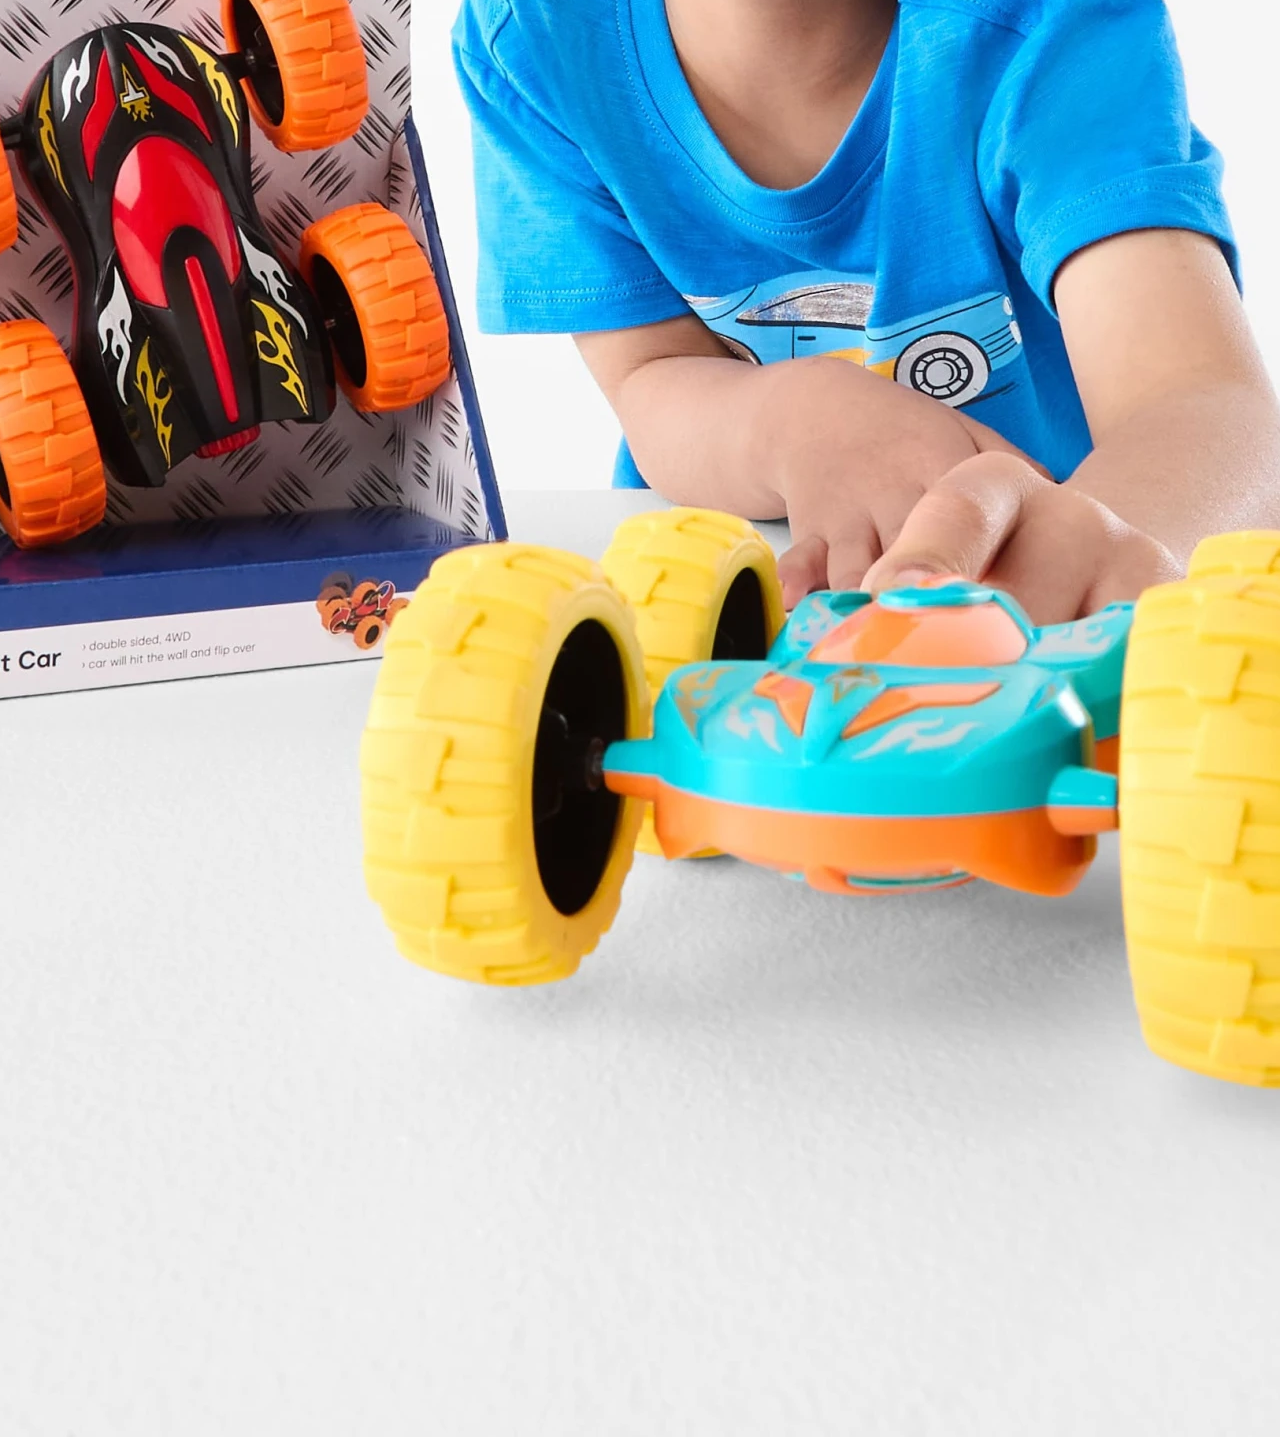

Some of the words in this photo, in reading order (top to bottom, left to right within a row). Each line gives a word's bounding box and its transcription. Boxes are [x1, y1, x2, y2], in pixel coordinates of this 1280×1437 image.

[89, 638, 127, 651] double
[165, 631, 192, 643] 4WD
[18, 650, 62, 669] Car
[88, 659, 106, 669] car
[110, 656, 127, 667] will
[130, 653, 143, 665] hit
[147, 651, 164, 663] the
[167, 648, 188, 661] wall
[191, 646, 211, 658] and
[214, 644, 230, 658] flip
[232, 643, 256, 654] over
